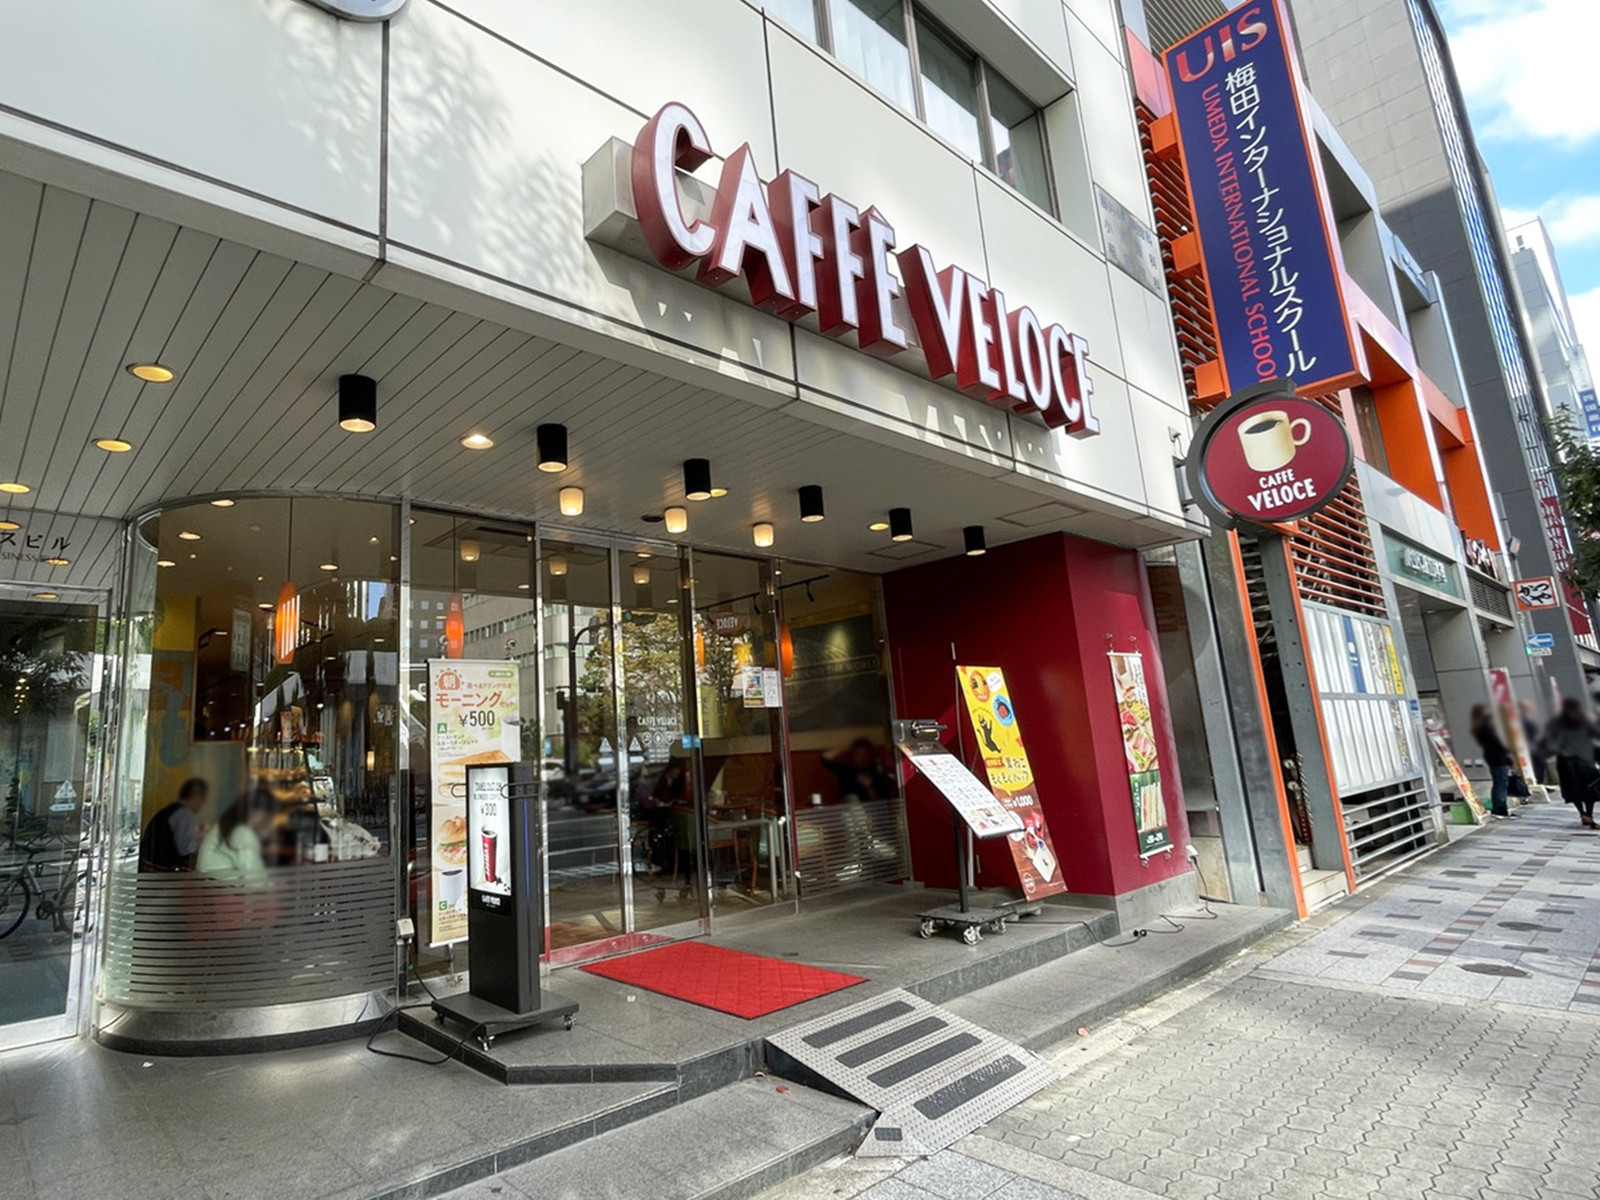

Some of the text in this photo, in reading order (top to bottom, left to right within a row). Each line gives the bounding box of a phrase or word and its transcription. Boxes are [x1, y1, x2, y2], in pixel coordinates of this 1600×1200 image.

[1175, 8, 1267, 82] UIS
[1202, 83, 1229, 153] UMEDA
[1215, 151, 1261, 302] INTERNATIONAL
[1224, 62, 1316, 377] 梅田インターナショナルスクール
[900, 244, 1100, 439] VELOCE
[1246, 477, 1317, 512] VELOCE
[458, 709, 495, 728] ¥500
